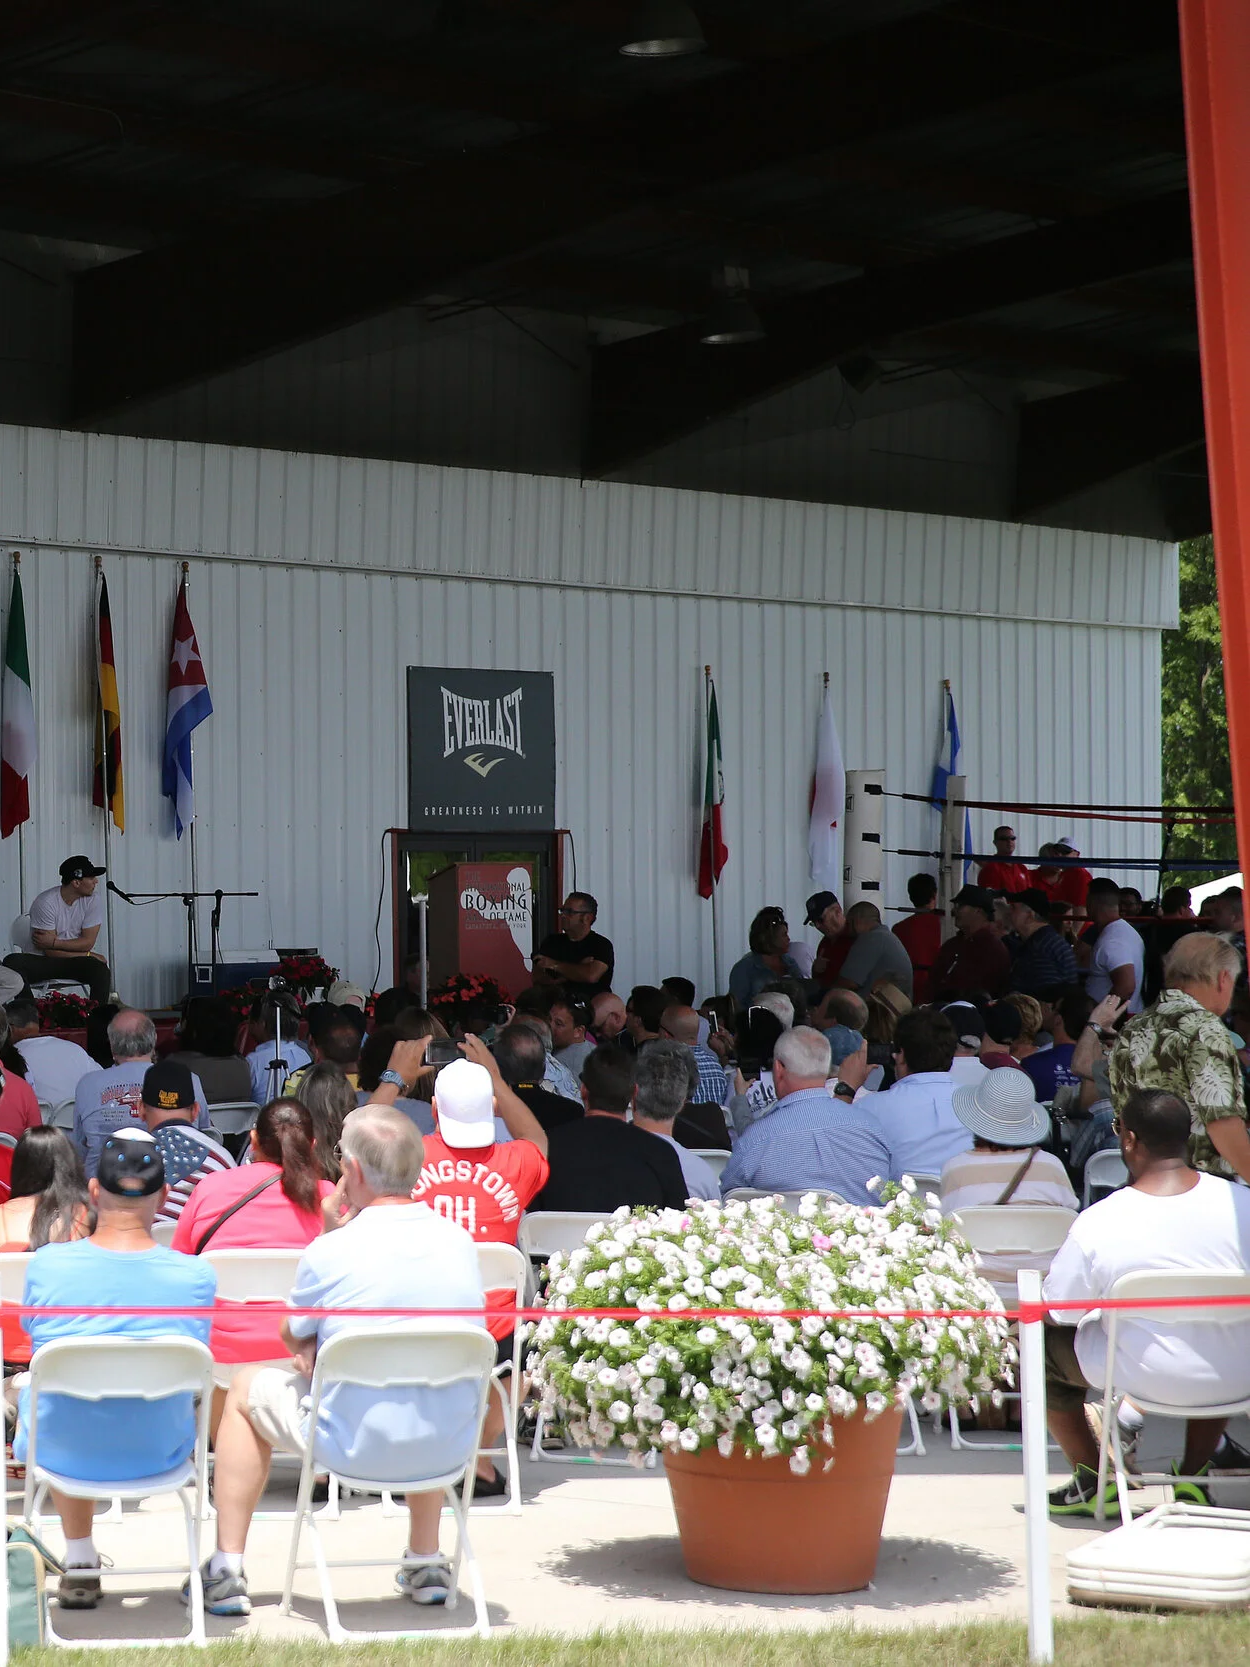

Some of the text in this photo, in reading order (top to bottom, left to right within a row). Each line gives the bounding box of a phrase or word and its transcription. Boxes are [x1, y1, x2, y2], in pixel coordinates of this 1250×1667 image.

[440, 685, 523, 758] EVERLAST
[424, 805, 544, 816] GREATNESS IS WITHIN
[465, 893, 527, 911] BOXING
[465, 911, 527, 922] HALL OF FAME
[410, 1159, 522, 1224] UNGSTOWN
